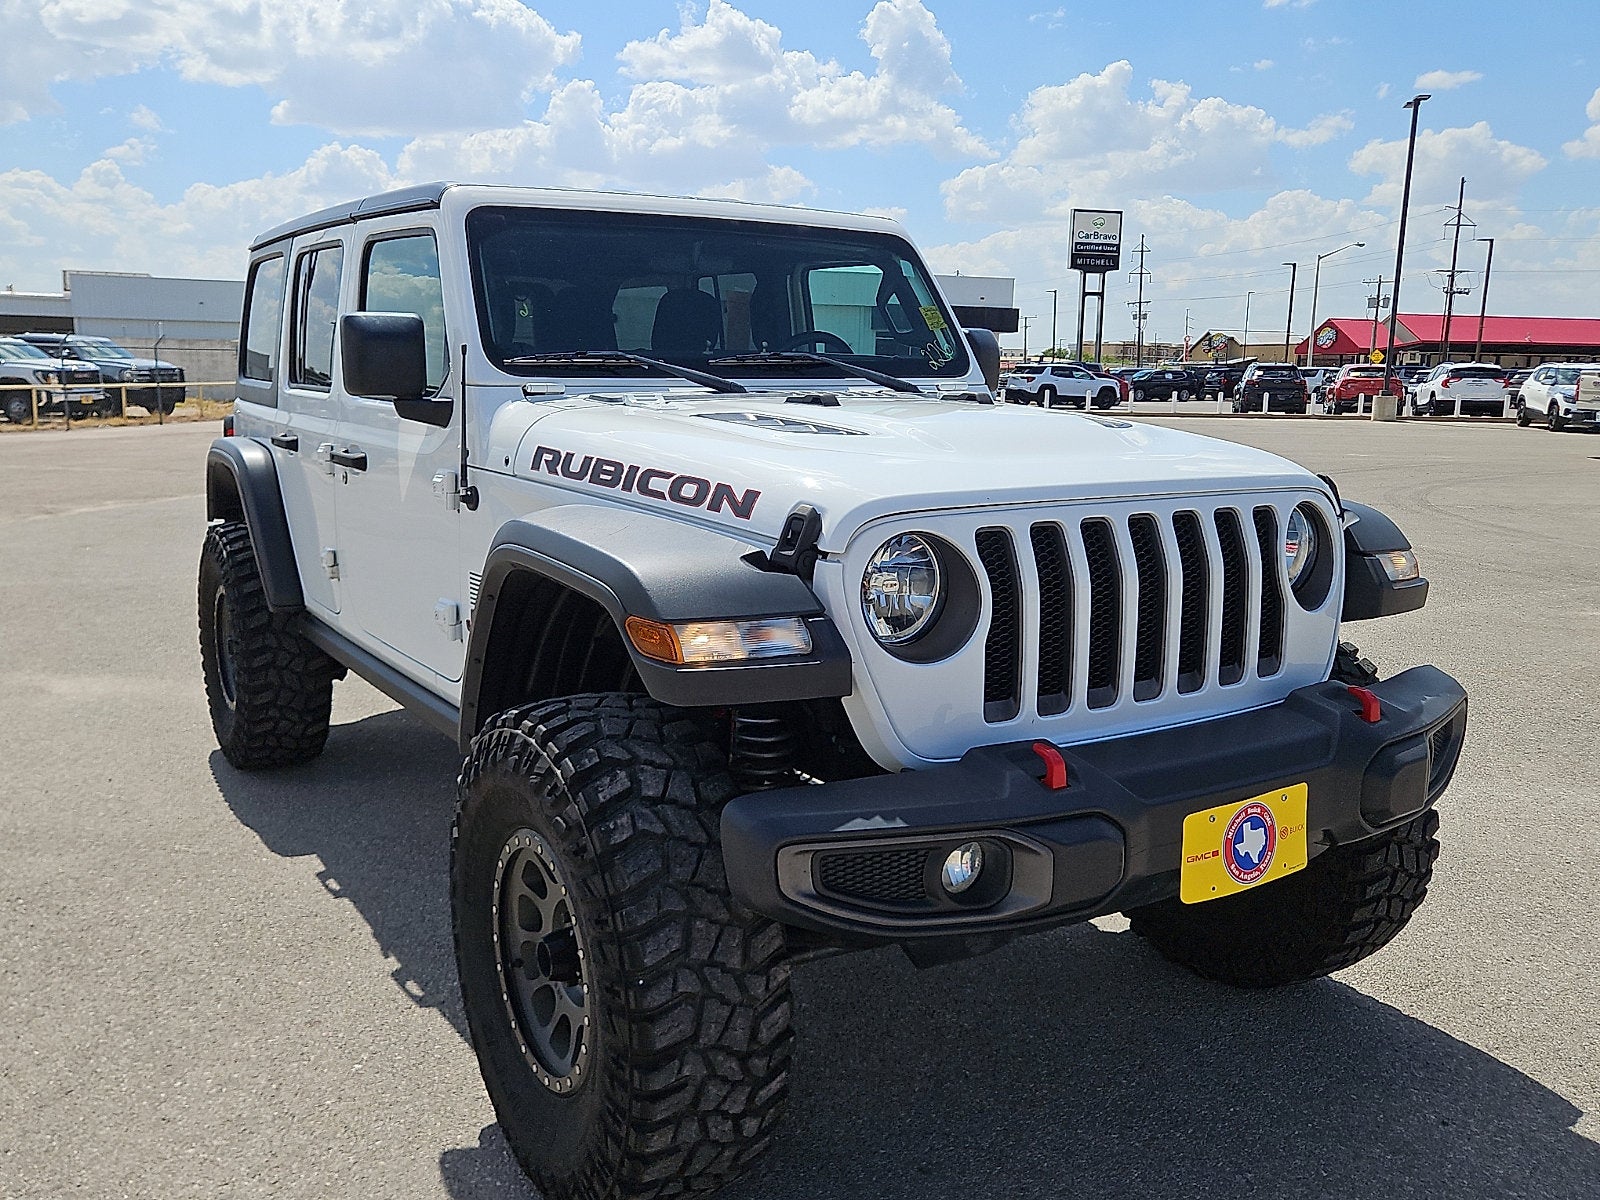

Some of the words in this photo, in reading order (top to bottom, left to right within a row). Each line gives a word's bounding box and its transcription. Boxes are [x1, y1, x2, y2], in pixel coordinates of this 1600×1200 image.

[1077, 230, 1117, 241] CarBravo
[1076, 258, 1114, 266] MITCHELL
[530, 444, 762, 521] RUBICON
[1227, 811, 1246, 840] Mitchell
[1186, 851, 1212, 863] GMC
